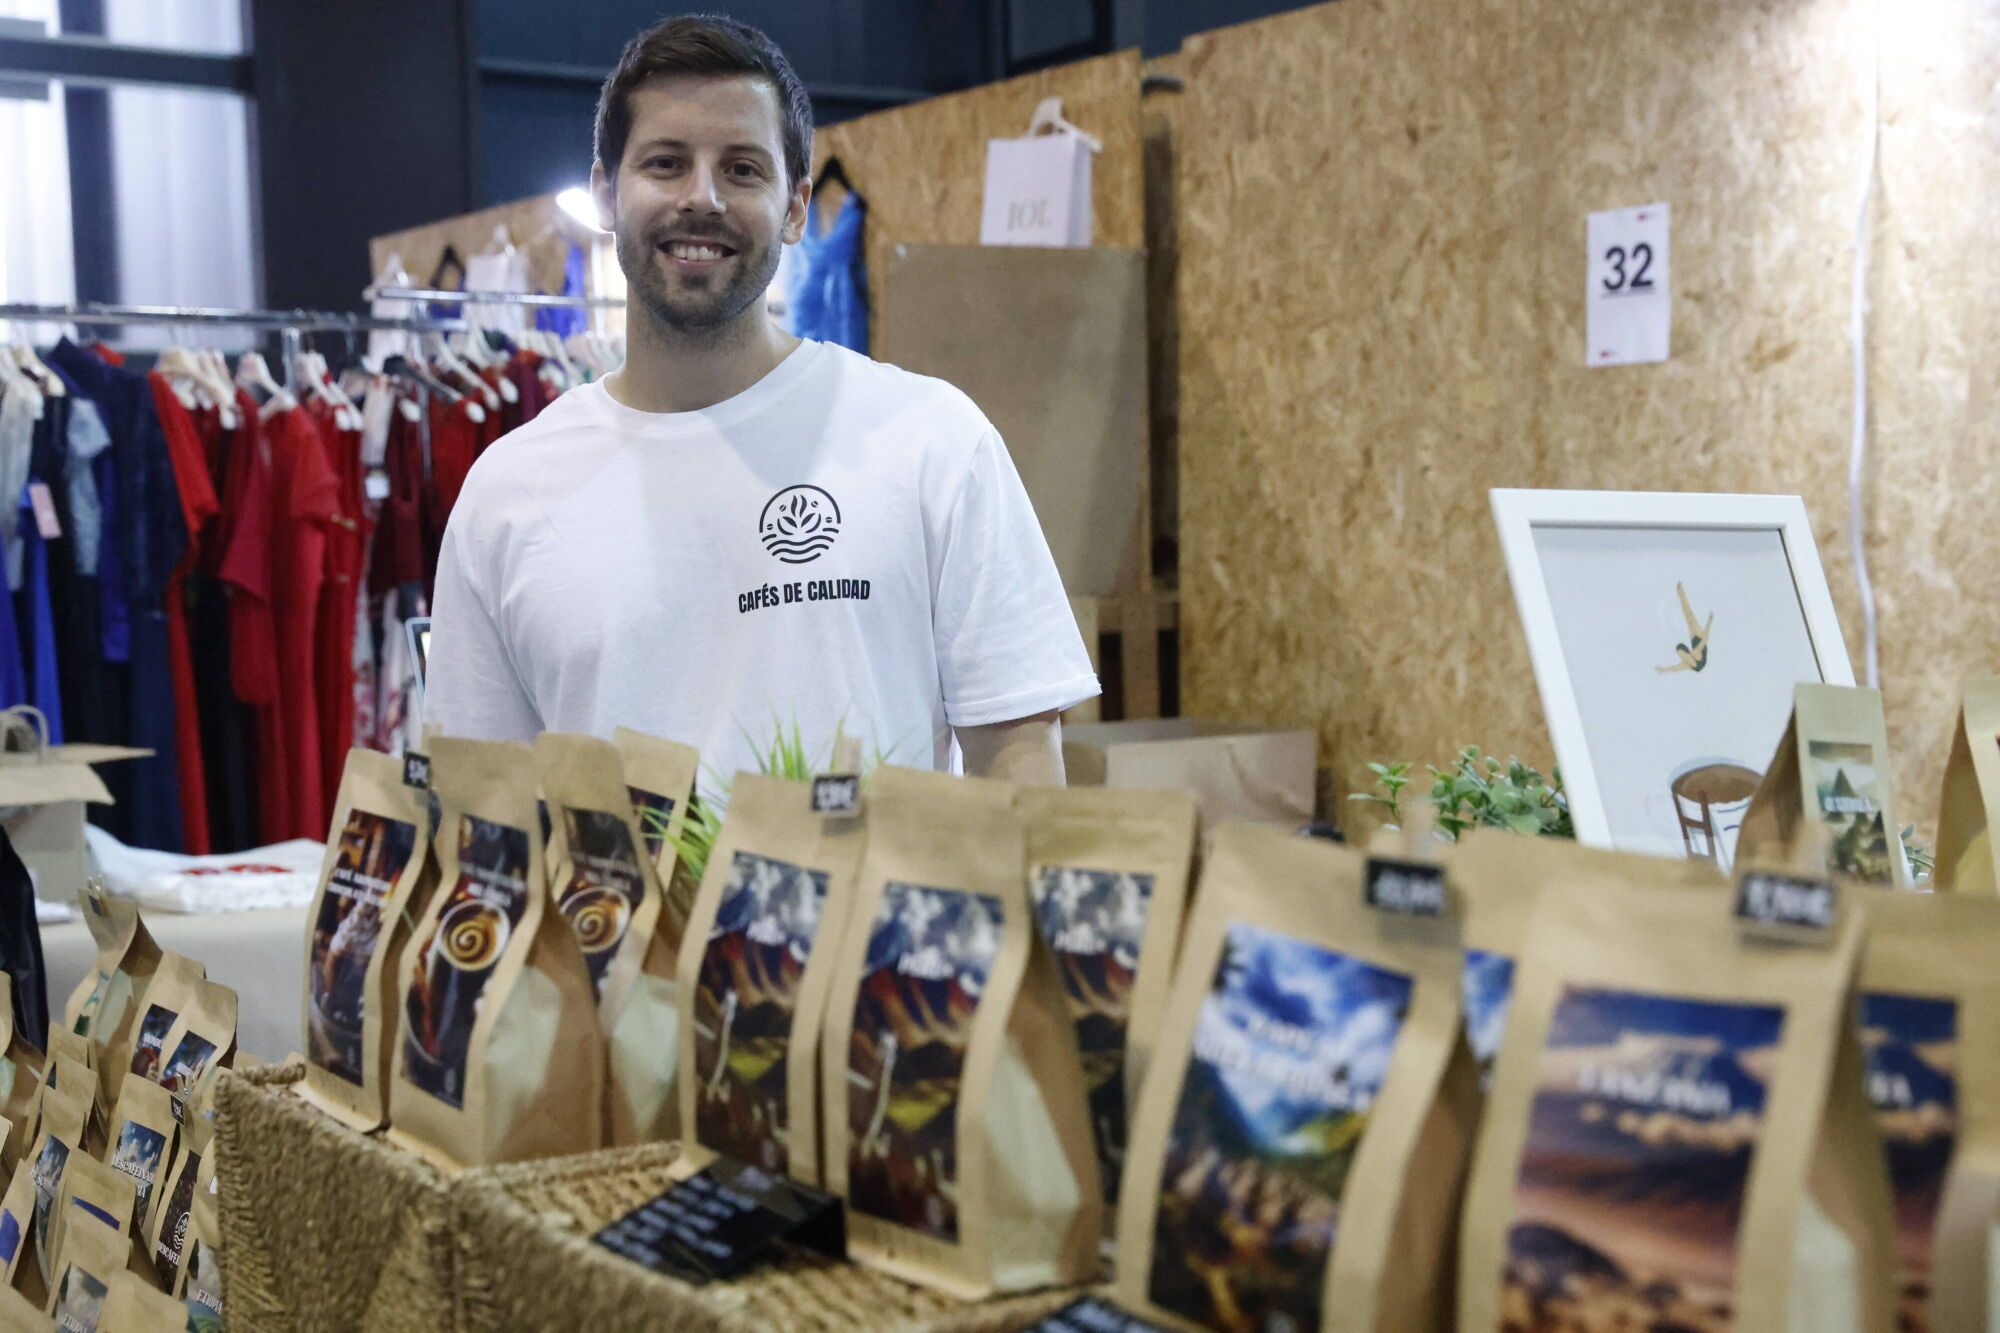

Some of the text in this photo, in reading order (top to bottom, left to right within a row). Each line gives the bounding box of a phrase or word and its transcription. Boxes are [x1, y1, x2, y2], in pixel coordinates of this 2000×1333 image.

[1603, 243, 1654, 290] 32
[738, 578, 871, 614] CAFÉS DE CALIDAD
